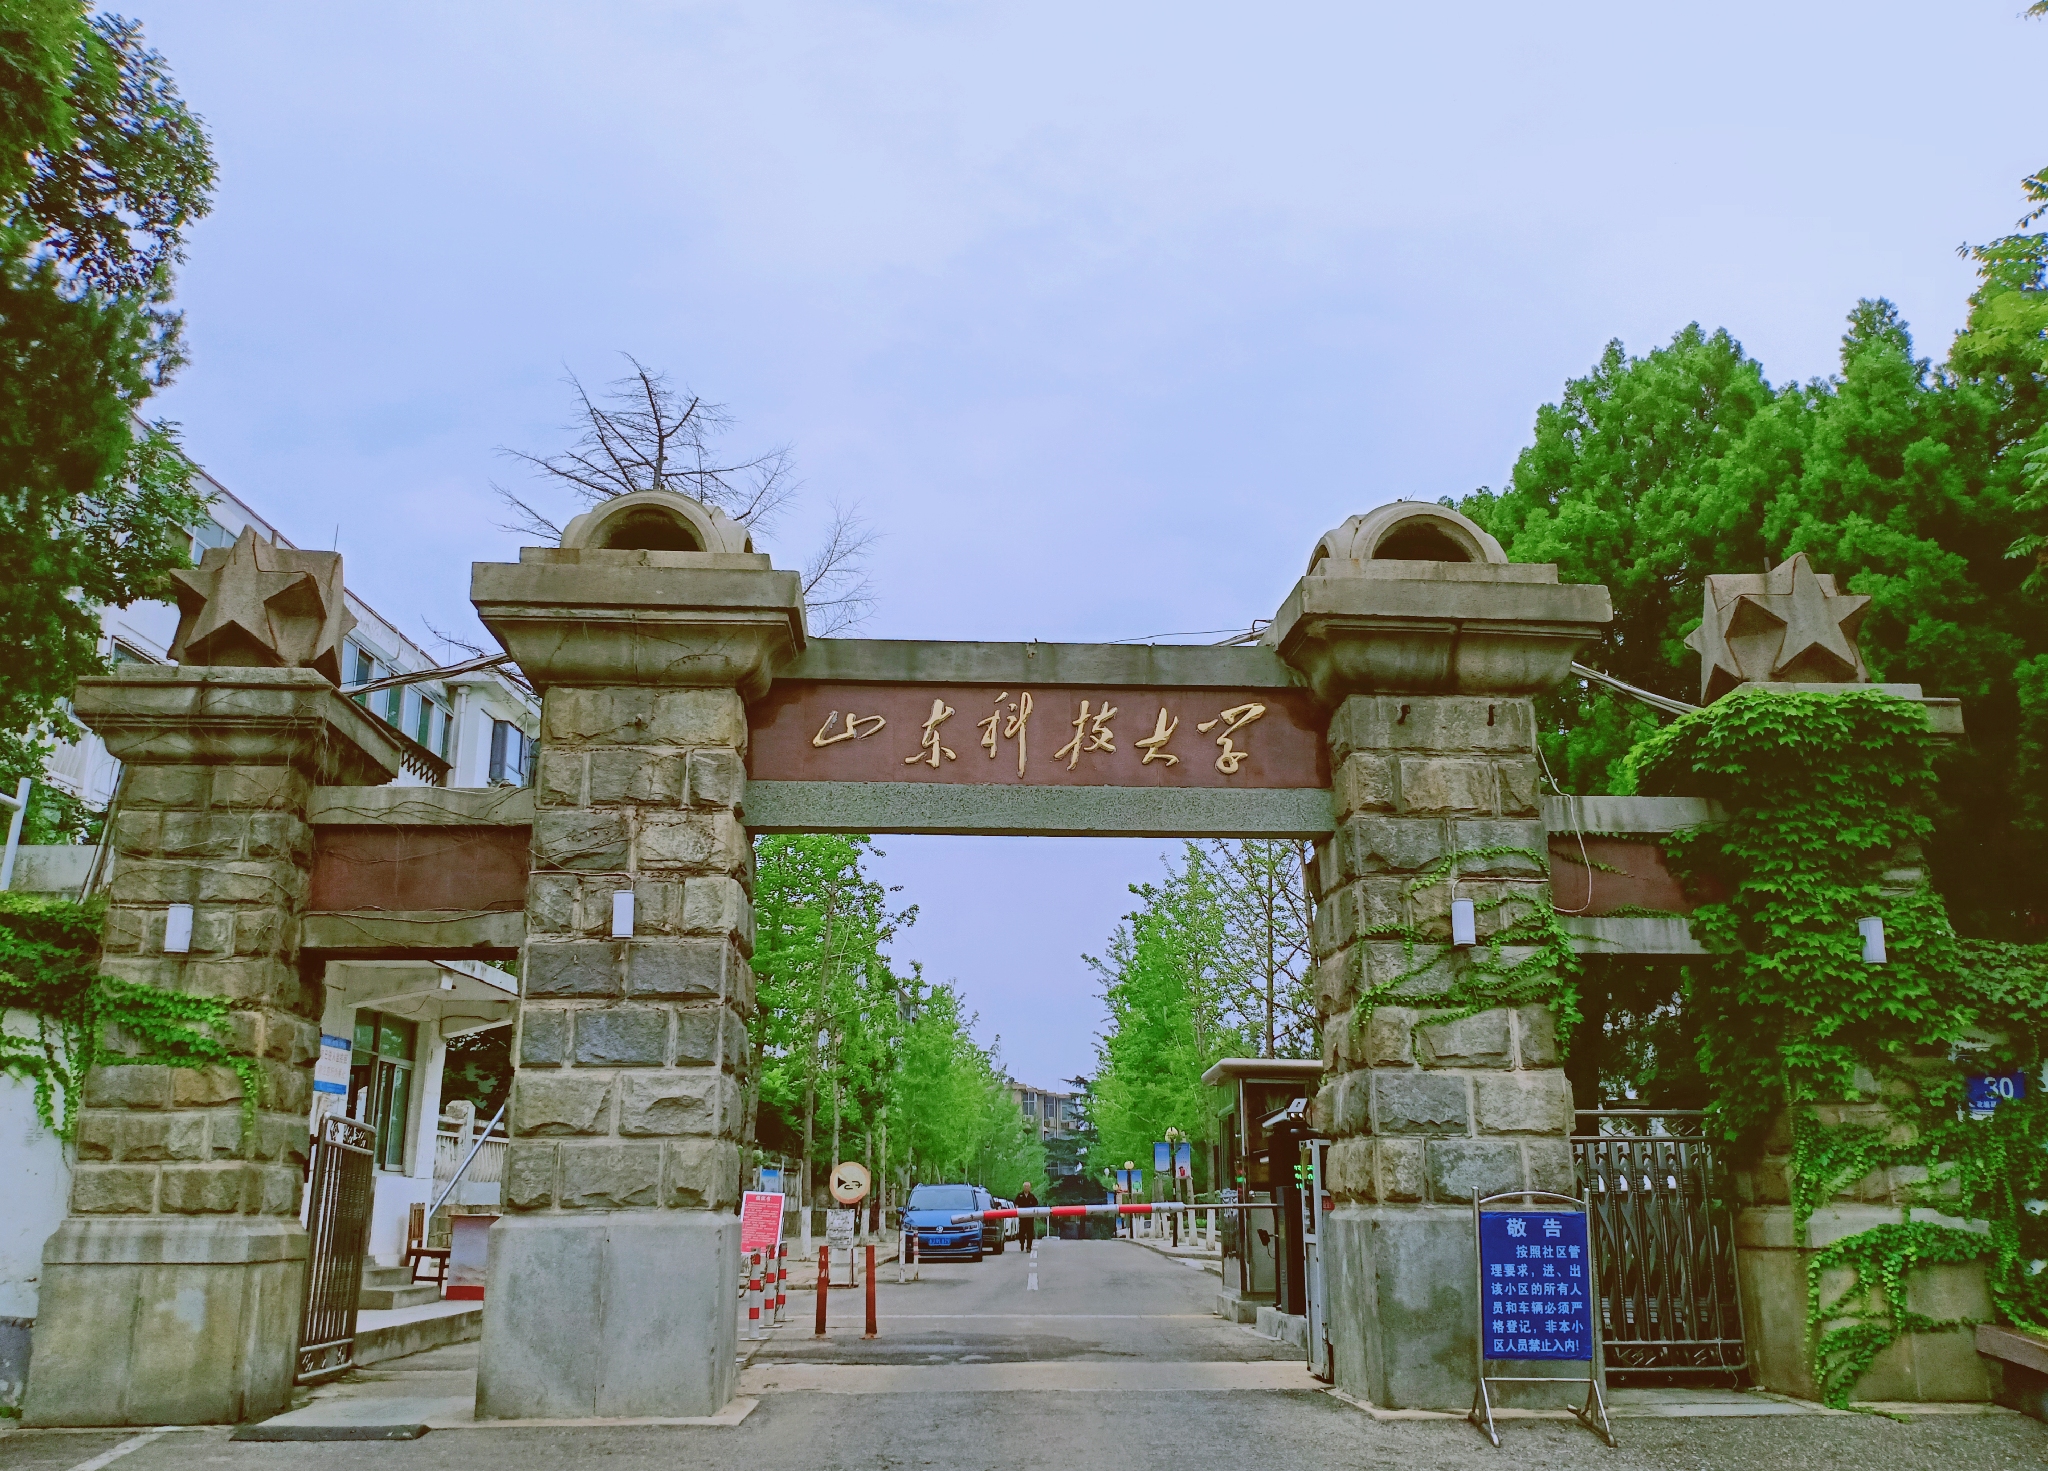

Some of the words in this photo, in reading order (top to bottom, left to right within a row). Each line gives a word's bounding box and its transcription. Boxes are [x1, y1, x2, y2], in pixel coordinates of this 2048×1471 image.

[812, 690, 1267, 779] 山东科技大学
[1984, 1076, 2014, 1100] 30
[1506, 1218, 1563, 1237] 敬告
[1516, 1245, 1581, 1259] 按照社区管
[1490, 1282, 1582, 1296] 该小区的所有人
[1492, 1301, 1583, 1315] 员和车辆必须严
